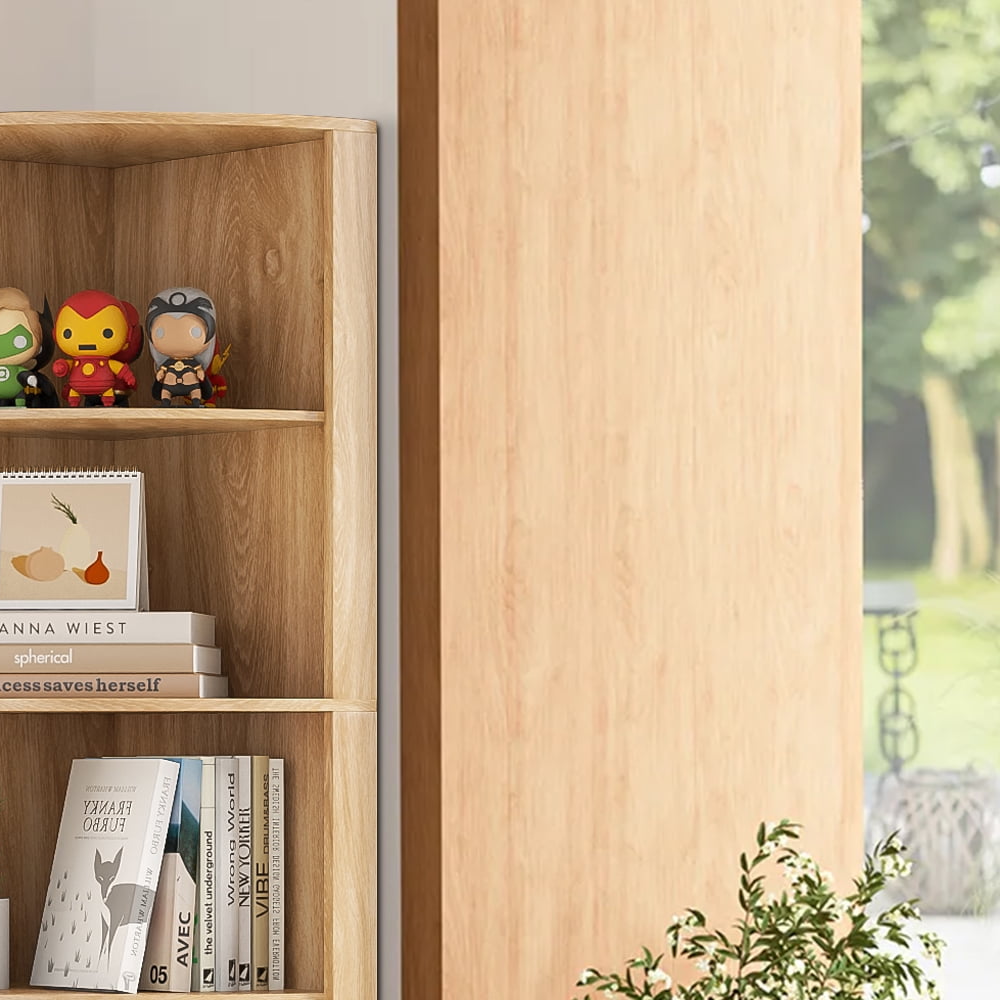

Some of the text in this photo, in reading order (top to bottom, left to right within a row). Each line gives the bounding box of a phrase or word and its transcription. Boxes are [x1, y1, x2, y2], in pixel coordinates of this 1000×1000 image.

[66, 622, 128, 635] WIEST
[13, 648, 73, 667] spherical
[43, 680, 93, 692] saves
[95, 678, 162, 692] herself
[228, 840, 236, 907] Wrong
[239, 807, 251, 907] NEW YORKER
[204, 831, 214, 955] the velvet underground
[256, 862, 269, 918] VIBE
[176, 912, 191, 967] AVEC
[150, 965, 168, 984] 05
